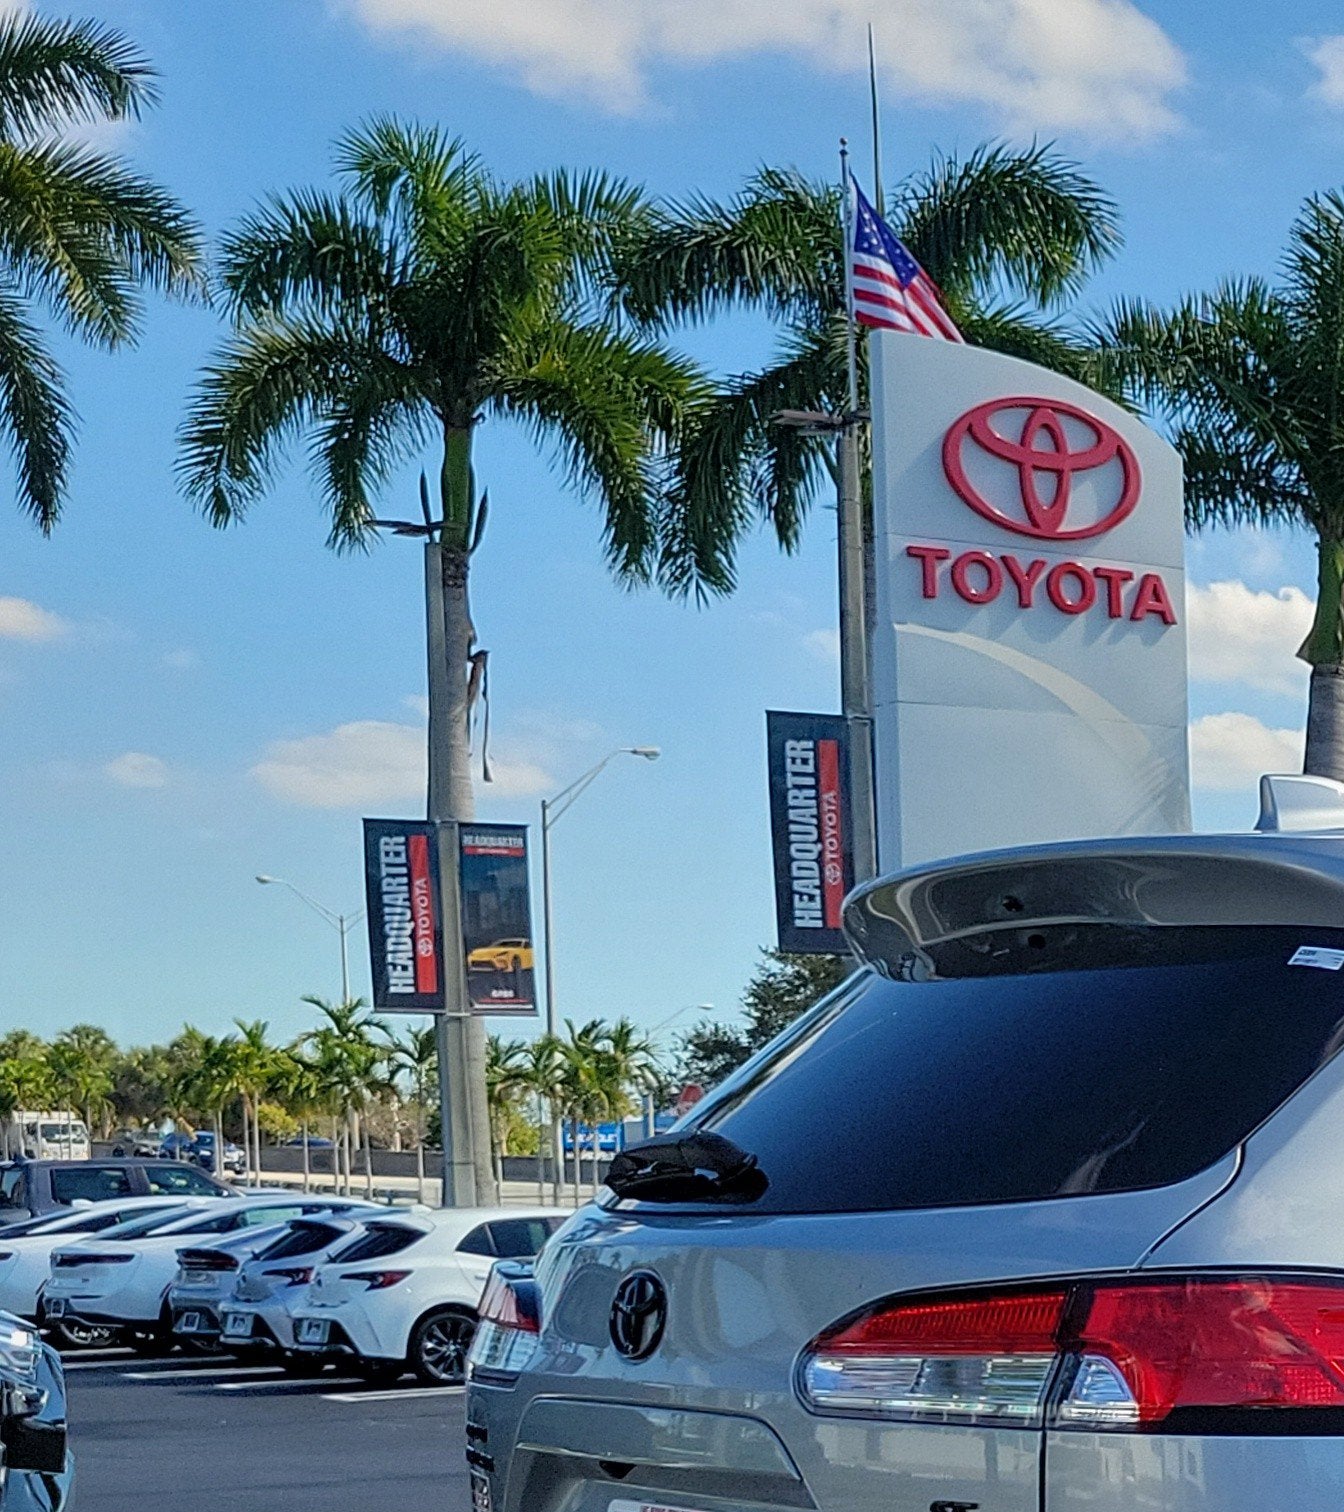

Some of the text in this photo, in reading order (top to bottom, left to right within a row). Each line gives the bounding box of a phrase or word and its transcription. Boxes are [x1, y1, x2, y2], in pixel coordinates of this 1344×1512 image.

[906, 545, 1177, 625] TOYOTA
[785, 739, 824, 929] HEADQUARTER
[823, 790, 842, 860] TOYOTA
[379, 835, 415, 994] HEADQUARTER
[413, 878, 433, 941] TOYOTA
